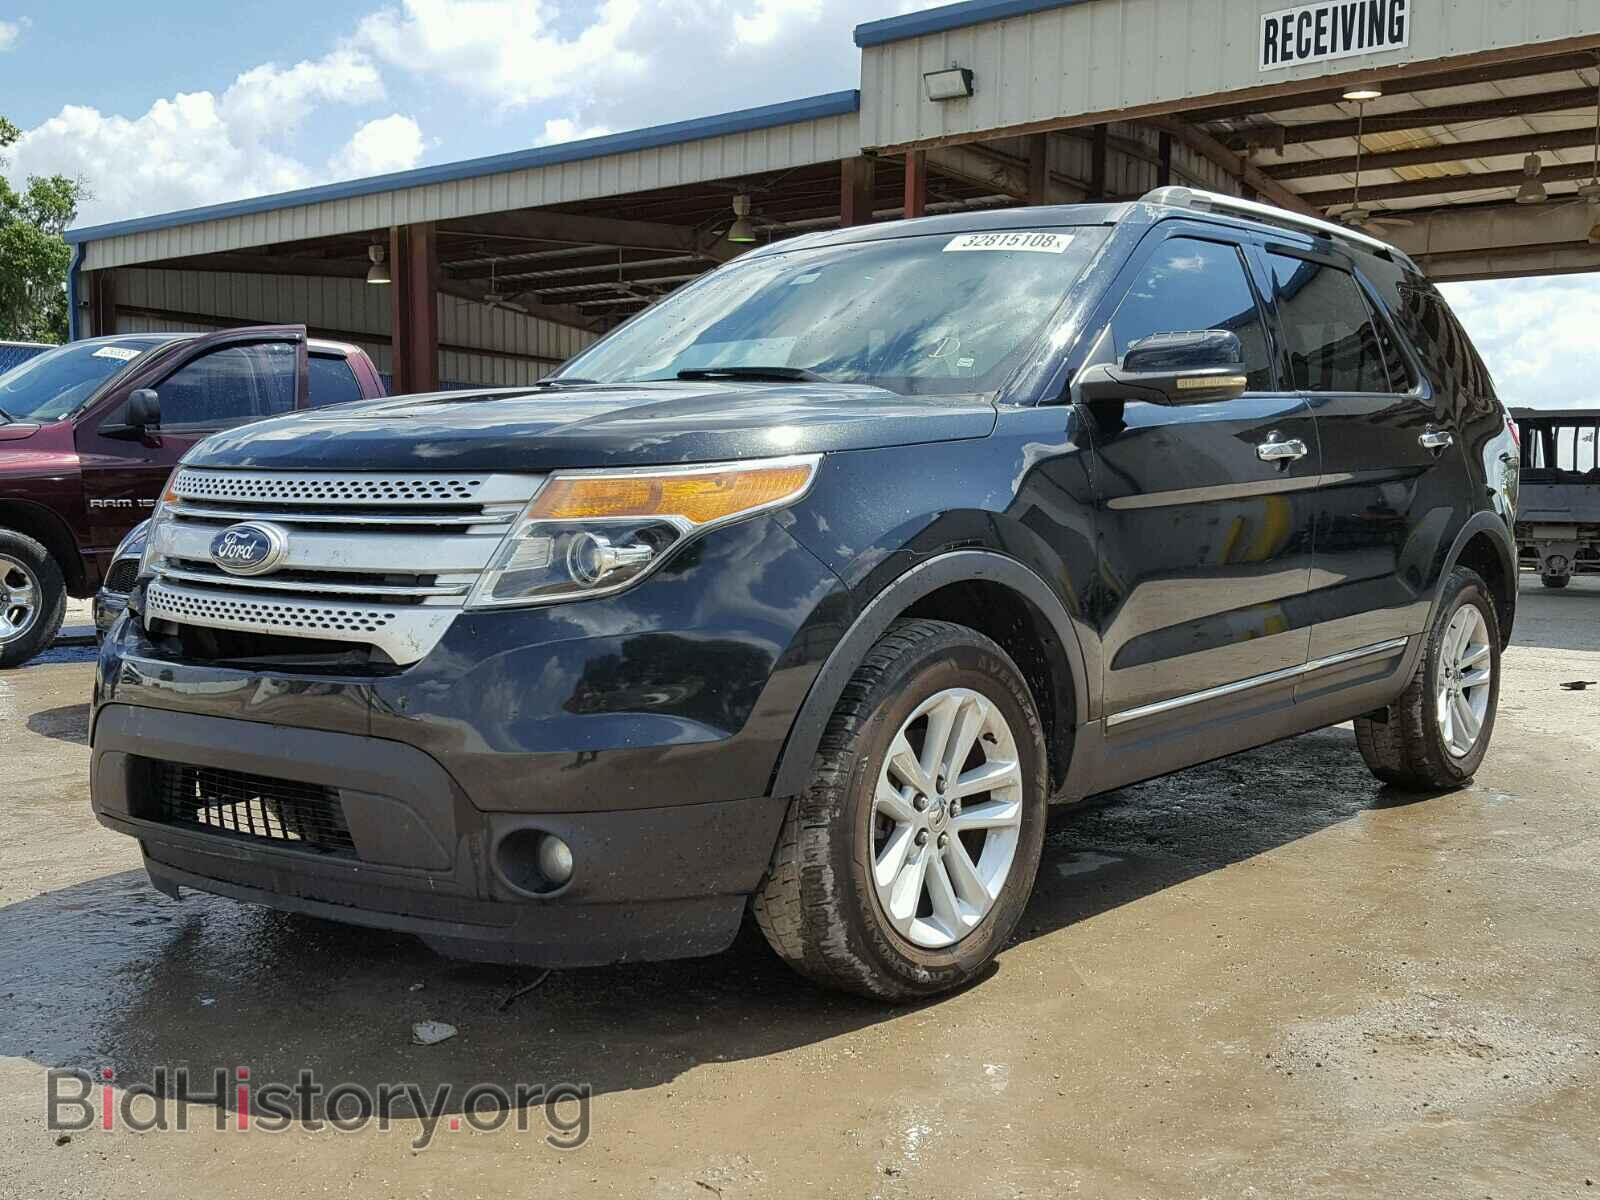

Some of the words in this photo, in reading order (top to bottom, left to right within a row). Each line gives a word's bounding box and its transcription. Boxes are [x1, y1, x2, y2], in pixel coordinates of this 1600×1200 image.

[1263, 0, 1405, 65] RECEIVING
[962, 234, 1056, 248] 32815108
[90, 499, 132, 508] RAM
[136, 499, 159, 507] 15
[218, 531, 257, 559] Ford
